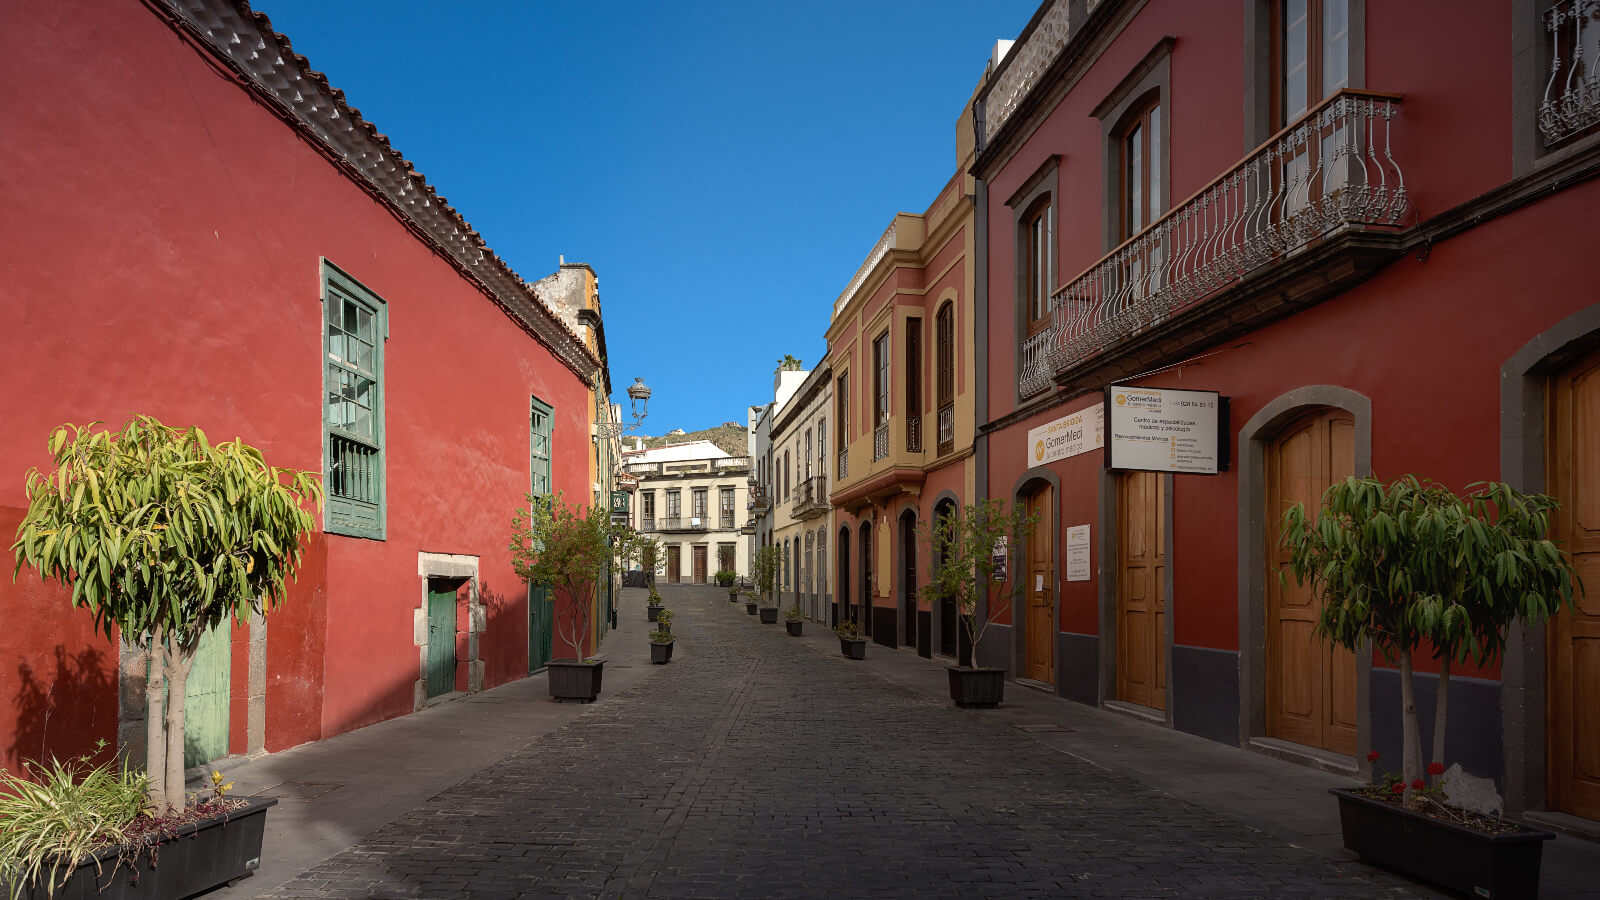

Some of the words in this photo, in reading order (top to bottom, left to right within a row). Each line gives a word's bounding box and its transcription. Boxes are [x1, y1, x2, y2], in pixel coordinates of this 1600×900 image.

[1126, 394, 1162, 403] GomerMedi
[1047, 423, 1063, 434] SANTA
[1045, 426, 1083, 449] GomerMedi
[1114, 433, 1151, 441] Reconocimientos
